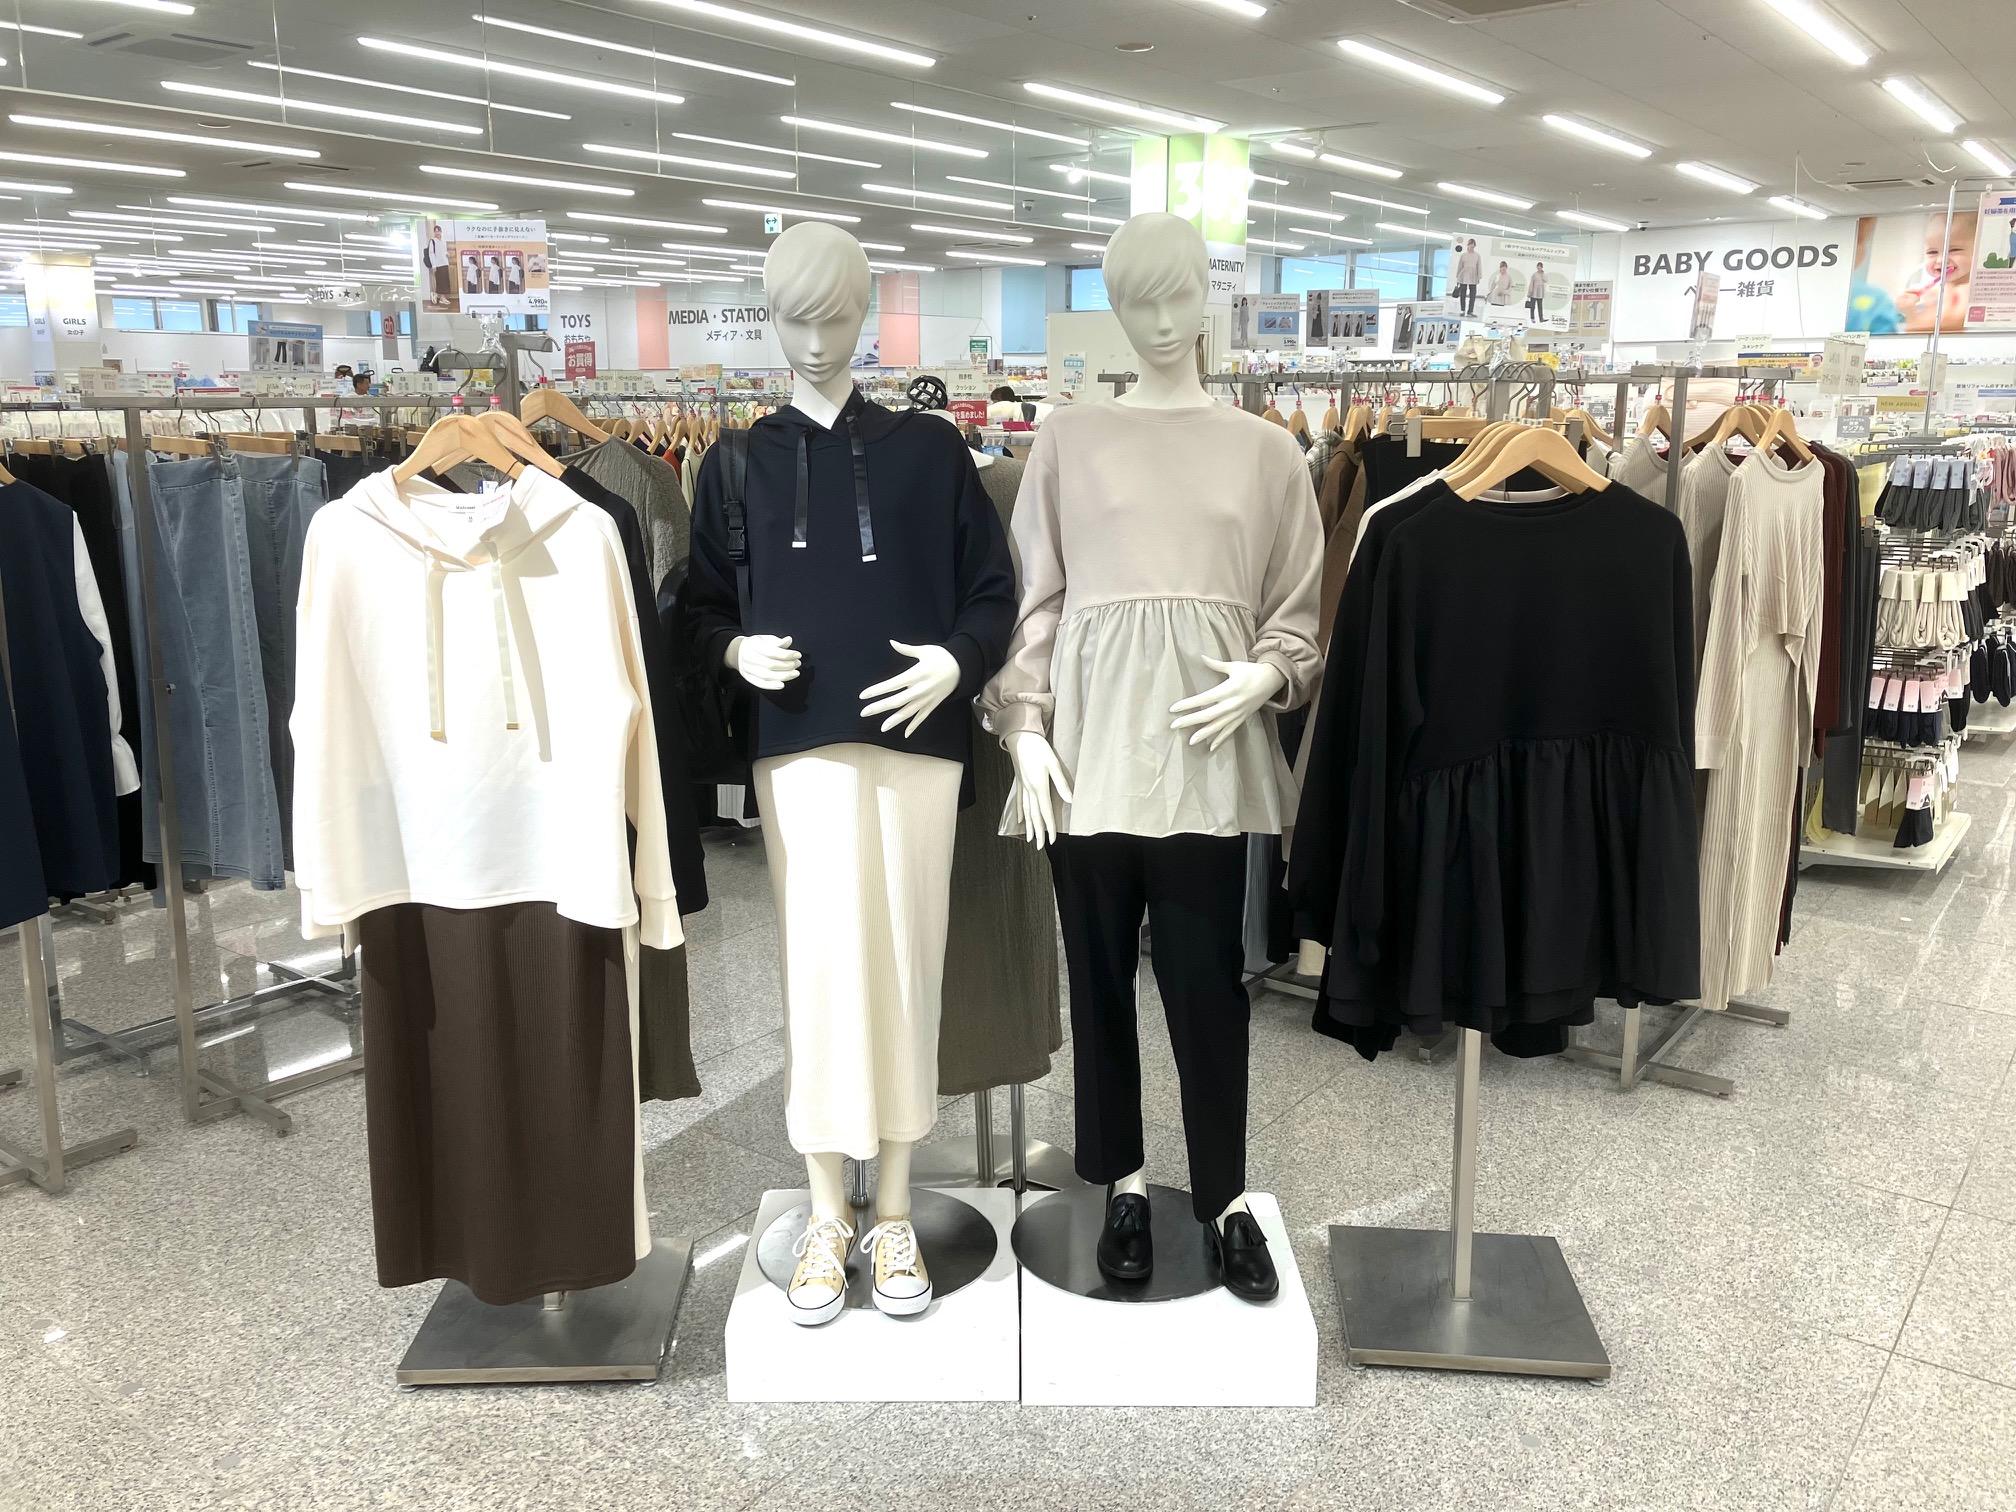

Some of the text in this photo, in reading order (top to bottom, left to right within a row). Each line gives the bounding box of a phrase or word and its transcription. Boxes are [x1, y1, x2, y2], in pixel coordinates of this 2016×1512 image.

[1634, 244, 1839, 276] BABY GOODS
[1211, 280, 1237, 292] マタニティ
[1684, 279, 1775, 298] ベー雑貨
[560, 314, 591, 328] TOYS
[668, 309, 709, 325] MEDIA
[706, 329, 762, 341] メディア・文具
[568, 353, 593, 368] お買得
